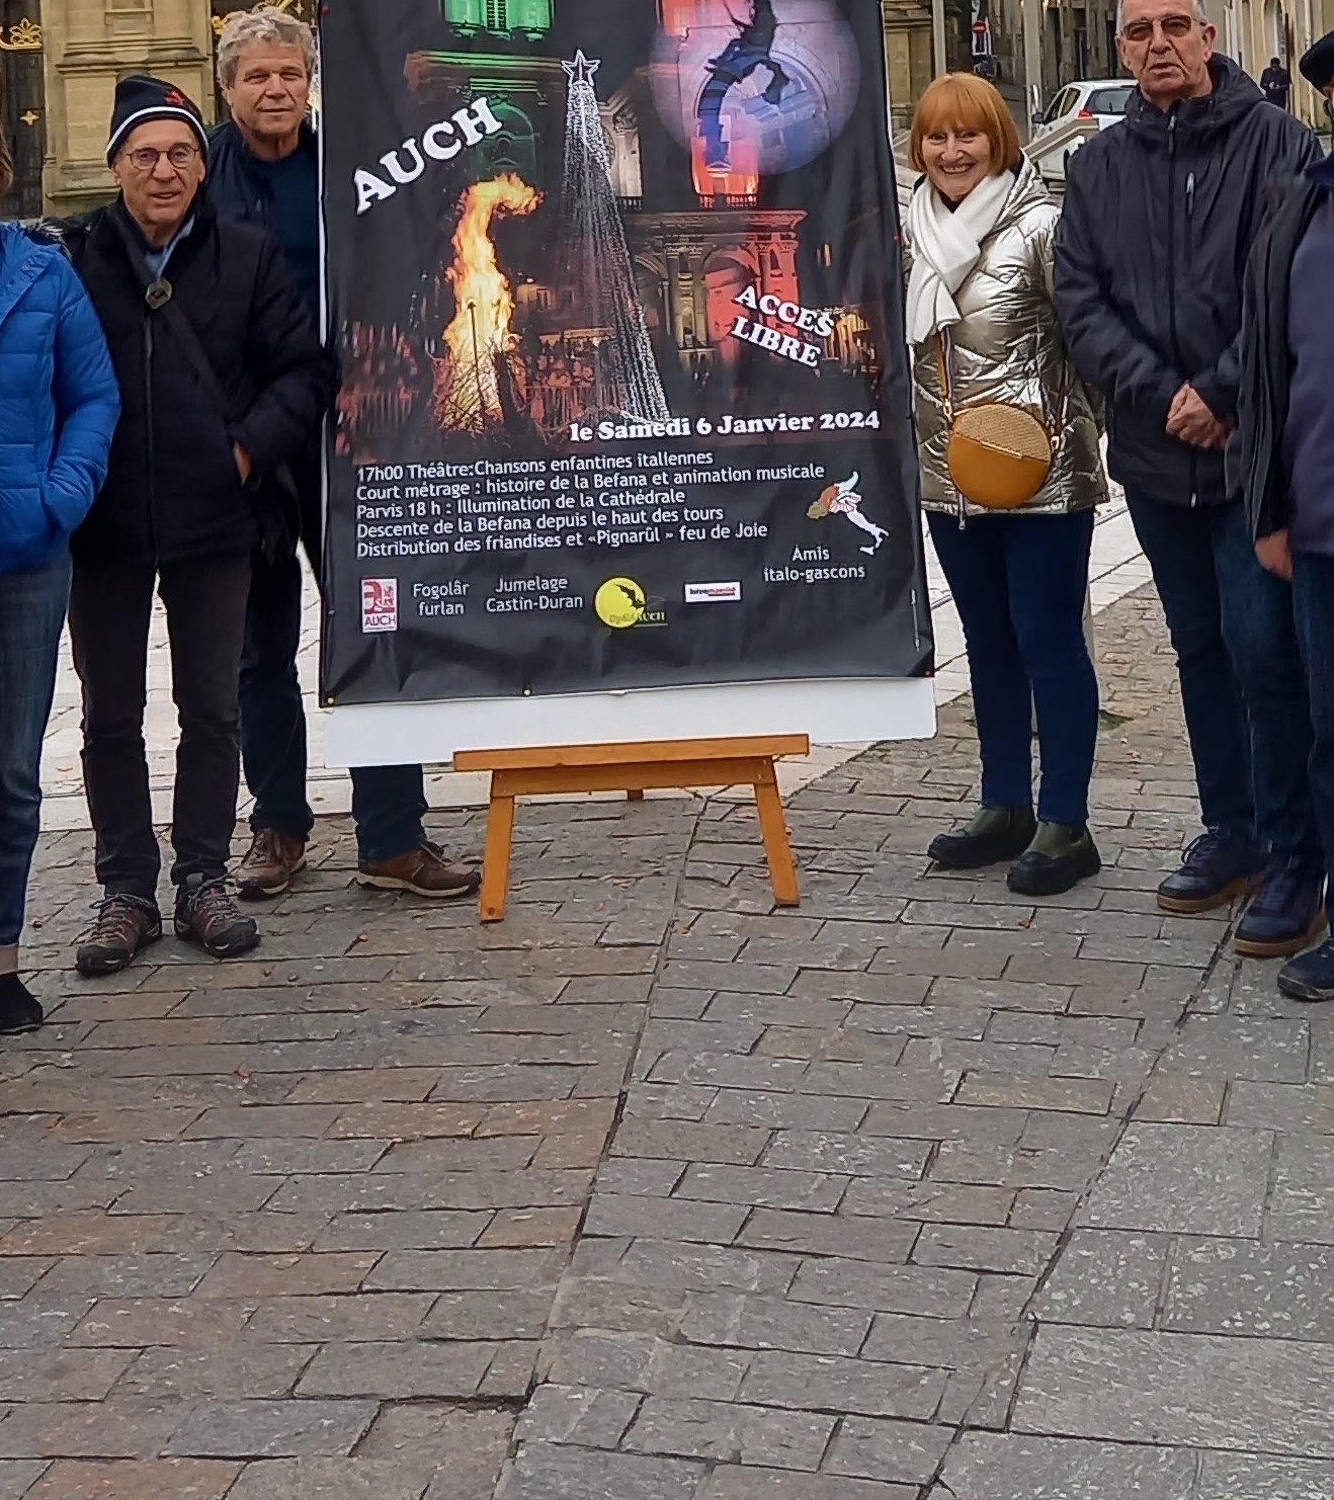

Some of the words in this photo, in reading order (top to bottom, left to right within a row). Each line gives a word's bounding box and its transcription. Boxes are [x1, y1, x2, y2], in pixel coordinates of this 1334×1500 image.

[353, 97, 503, 215] AUCH
[731, 316, 821, 367] LIBRE
[570, 423, 593, 442] le
[599, 418, 691, 440] Samedi
[696, 417, 712, 435] 6
[717, 414, 815, 434] Janvier
[820, 410, 880, 430] 2024
[357, 465, 403, 483] 17h00
[551, 454, 633, 474] enfantines
[637, 451, 714, 468] italiennes
[357, 485, 399, 501] Court
[405, 480, 470, 501] métrage
[486, 476, 546, 494] histoire
[550, 475, 569, 491] de
[575, 474, 589, 489] la
[594, 472, 648, 489] Befana
[652, 471, 670, 486] et
[673, 466, 753, 485] animation
[756, 463, 825, 482] musicale
[357, 503, 403, 520] Parvis
[408, 501, 426, 517] 18
[431, 500, 441, 516] h
[457, 496, 550, 515] Illumination
[555, 494, 575, 510] de
[580, 493, 594, 508] la
[599, 488, 685, 507] Cathédrale
[357, 520, 429, 539] Descente
[434, 518, 454, 535] de
[458, 517, 473, 533] la
[477, 515, 531, 532] Befana
[536, 511, 587, 533] depuis
[592, 511, 607, 527] le
[611, 509, 647, 526] haut
[652, 507, 679, 524] des
[683, 506, 724, 522] tours
[357, 539, 449, 559] Distribution
[454, 535, 481, 552] des
[485, 532, 562, 551] friandises
[566, 531, 584, 547] et
[679, 525, 706, 541] feu
[711, 524, 731, 540] de
[735, 522, 768, 539] Joie
[792, 547, 830, 562] Amis
[495, 576, 568, 595] Jumelage
[764, 564, 866, 583] italo-gascons
[413, 581, 470, 599] Fogolâr
[486, 594, 584, 613] Castin-Duran
[364, 615, 396, 627] AUCH
[418, 601, 464, 617] furlan
